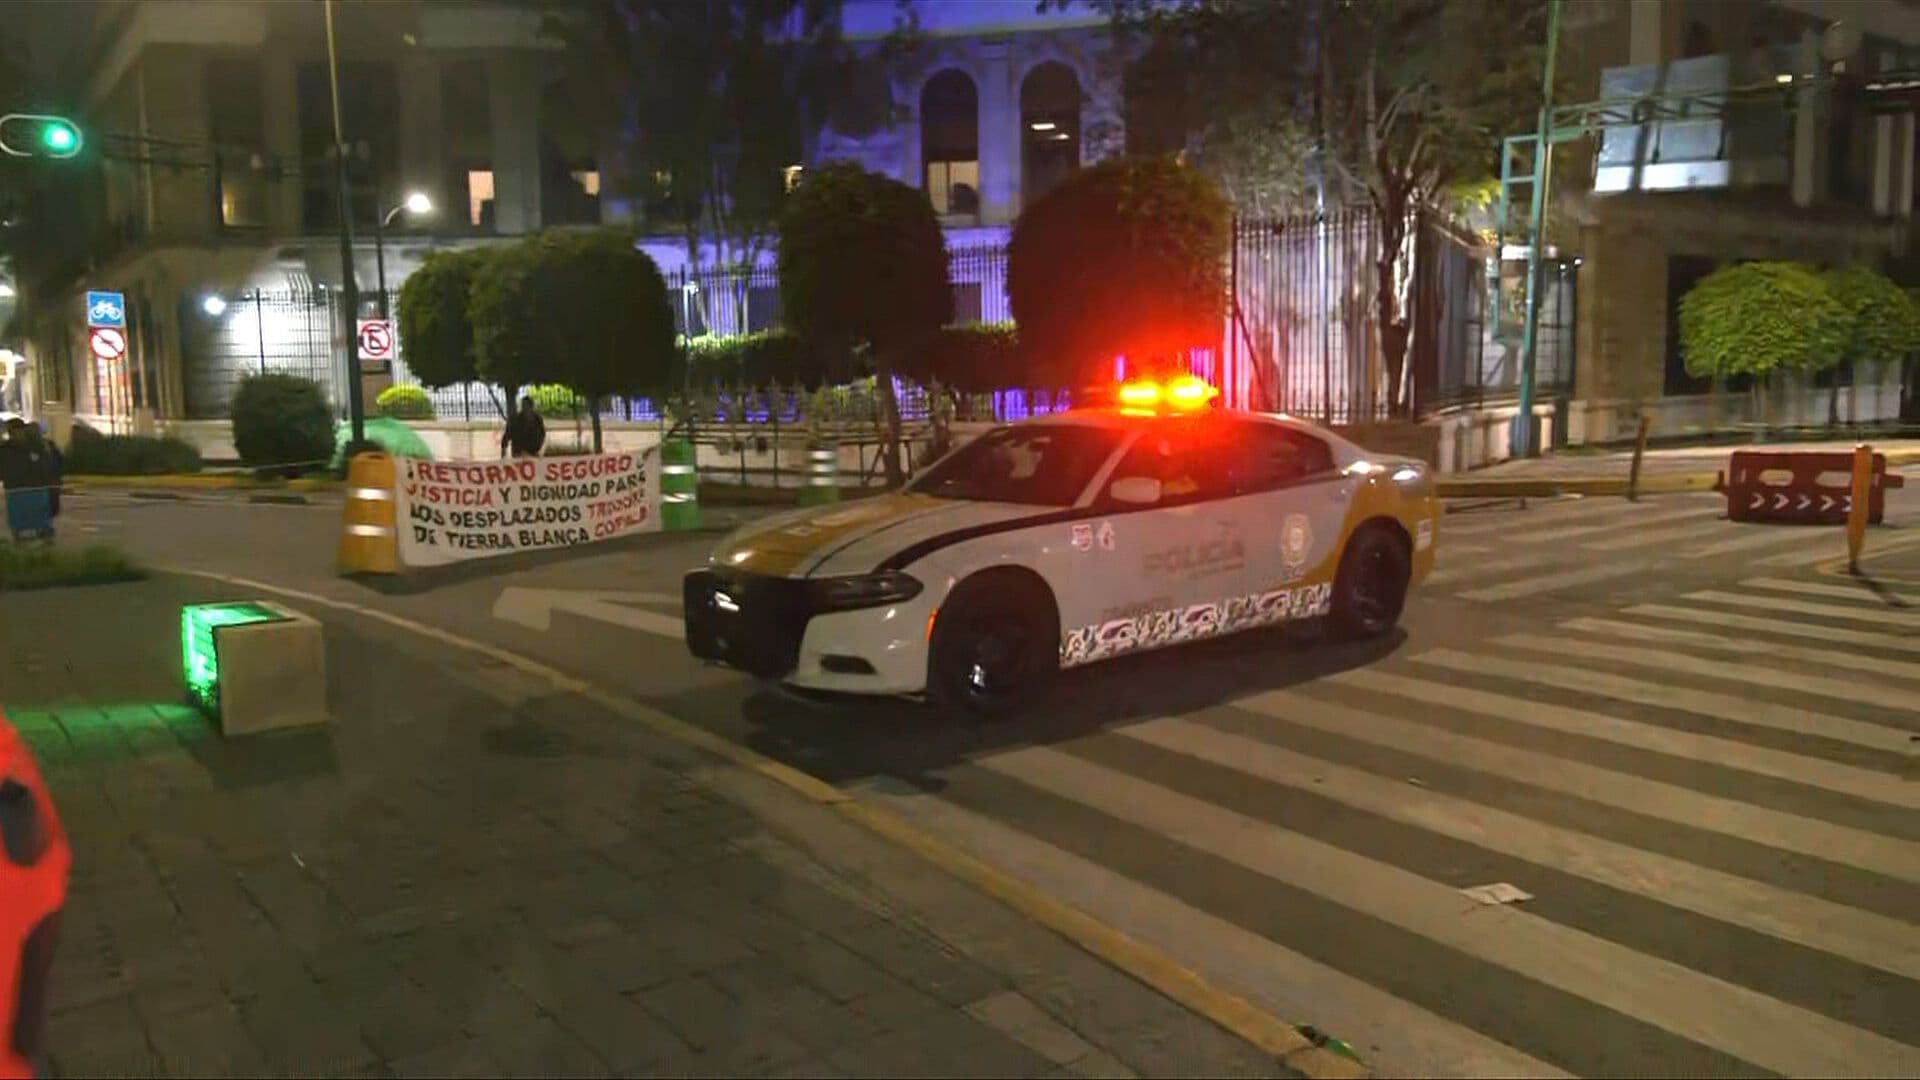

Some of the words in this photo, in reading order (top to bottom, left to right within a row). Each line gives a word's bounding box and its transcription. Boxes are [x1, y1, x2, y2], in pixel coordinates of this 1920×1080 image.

[499, 487, 511, 504] Y
[520, 482, 600, 501] DIGNIDAD
[410, 503, 443, 526] LOS
[449, 505, 582, 527] DESPLAZADOS
[413, 525, 436, 544] DE
[445, 531, 515, 549] TIERRA
[519, 527, 589, 546] BLANCA
